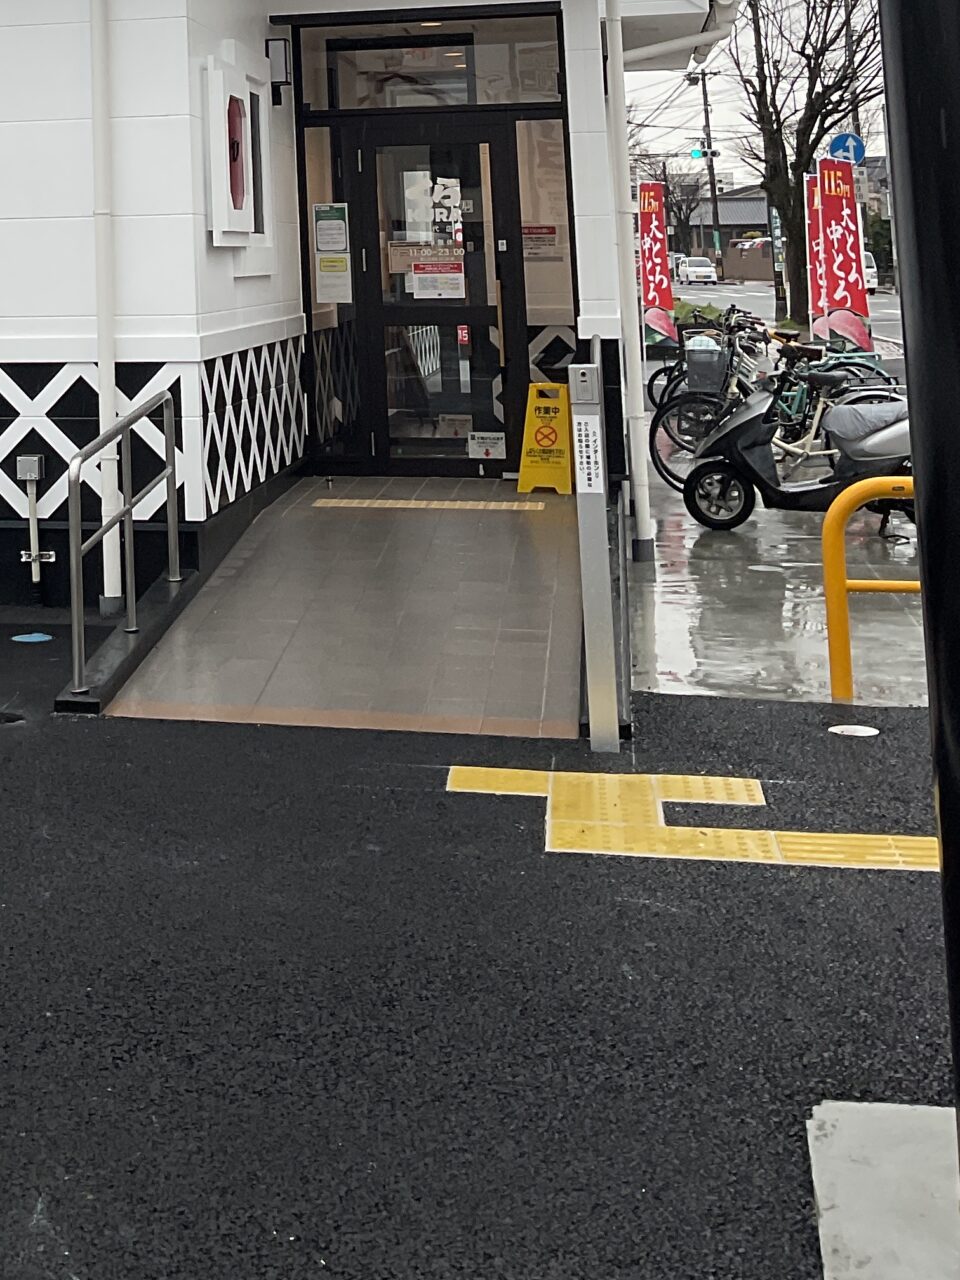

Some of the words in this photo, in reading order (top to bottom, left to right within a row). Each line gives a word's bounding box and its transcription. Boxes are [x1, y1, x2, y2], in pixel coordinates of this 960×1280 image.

[823, 170, 851, 198] 115円
[642, 232, 659, 306] 中とろ
[650, 213, 668, 289] 大とろ
[826, 220, 852, 308] 中とろ
[841, 199, 863, 290] 大とろ
[534, 405, 560, 415] 作業中
